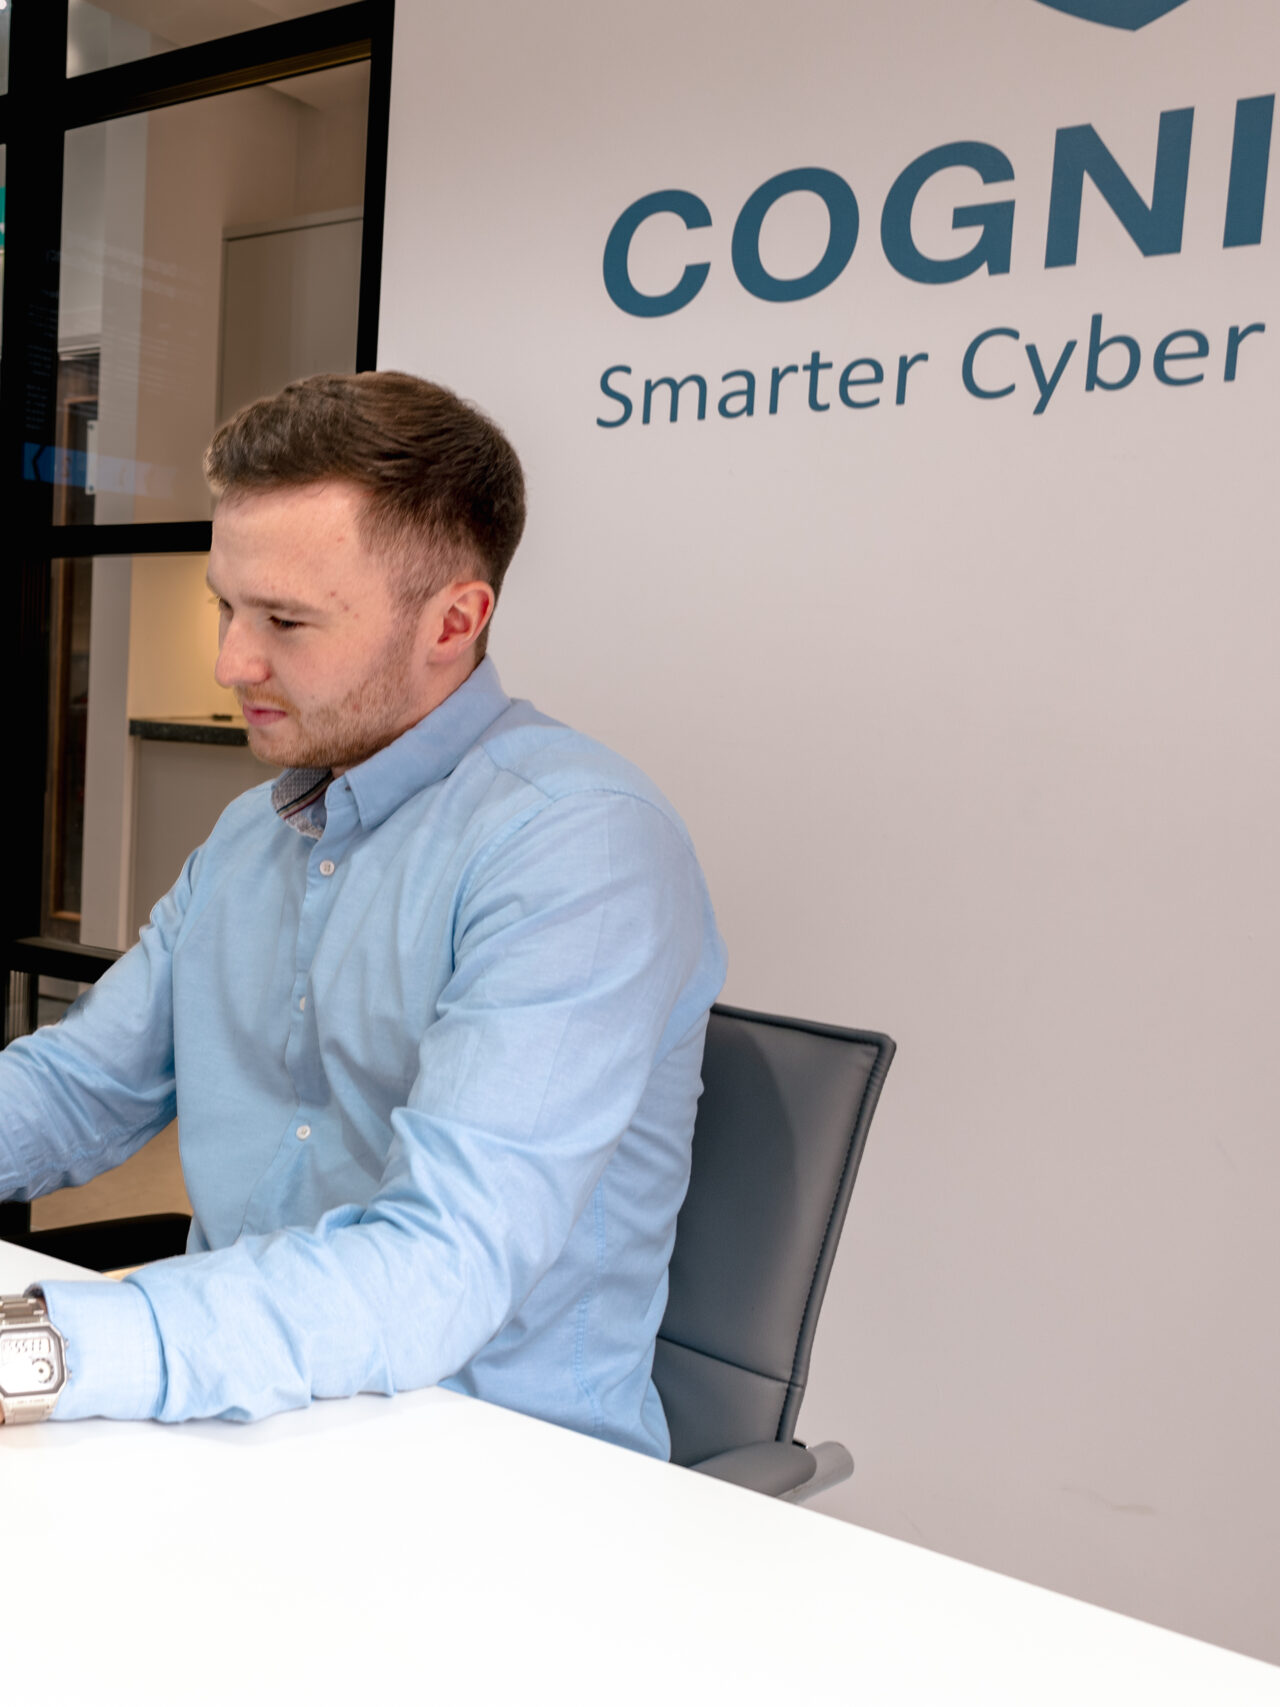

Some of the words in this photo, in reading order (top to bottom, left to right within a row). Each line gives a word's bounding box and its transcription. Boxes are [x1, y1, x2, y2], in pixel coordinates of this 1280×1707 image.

[602, 93, 1275, 318] COGNI
[596, 351, 929, 428] Smarter
[961, 313, 1266, 415] Cyber
